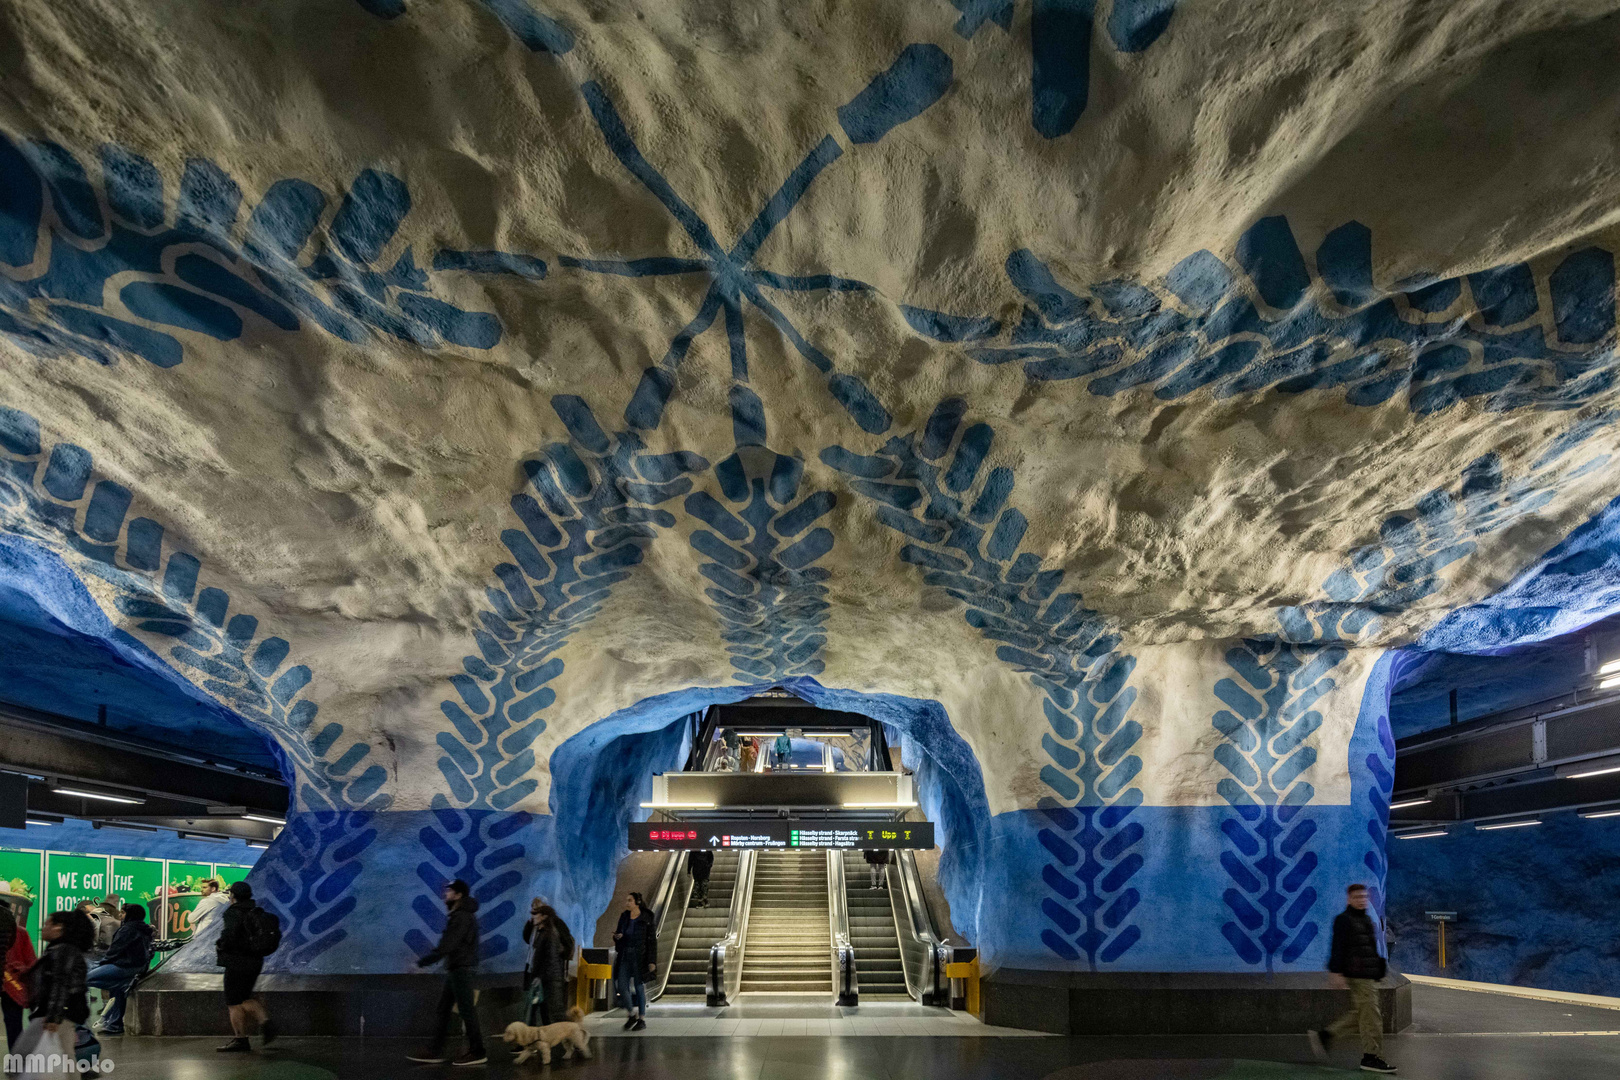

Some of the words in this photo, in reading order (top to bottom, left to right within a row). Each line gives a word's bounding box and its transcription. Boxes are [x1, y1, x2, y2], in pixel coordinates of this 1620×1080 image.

[882, 830, 896, 840] Upp
[58, 872, 78, 889] WE
[83, 873, 104, 890] GOT
[114, 874, 134, 891] THE
